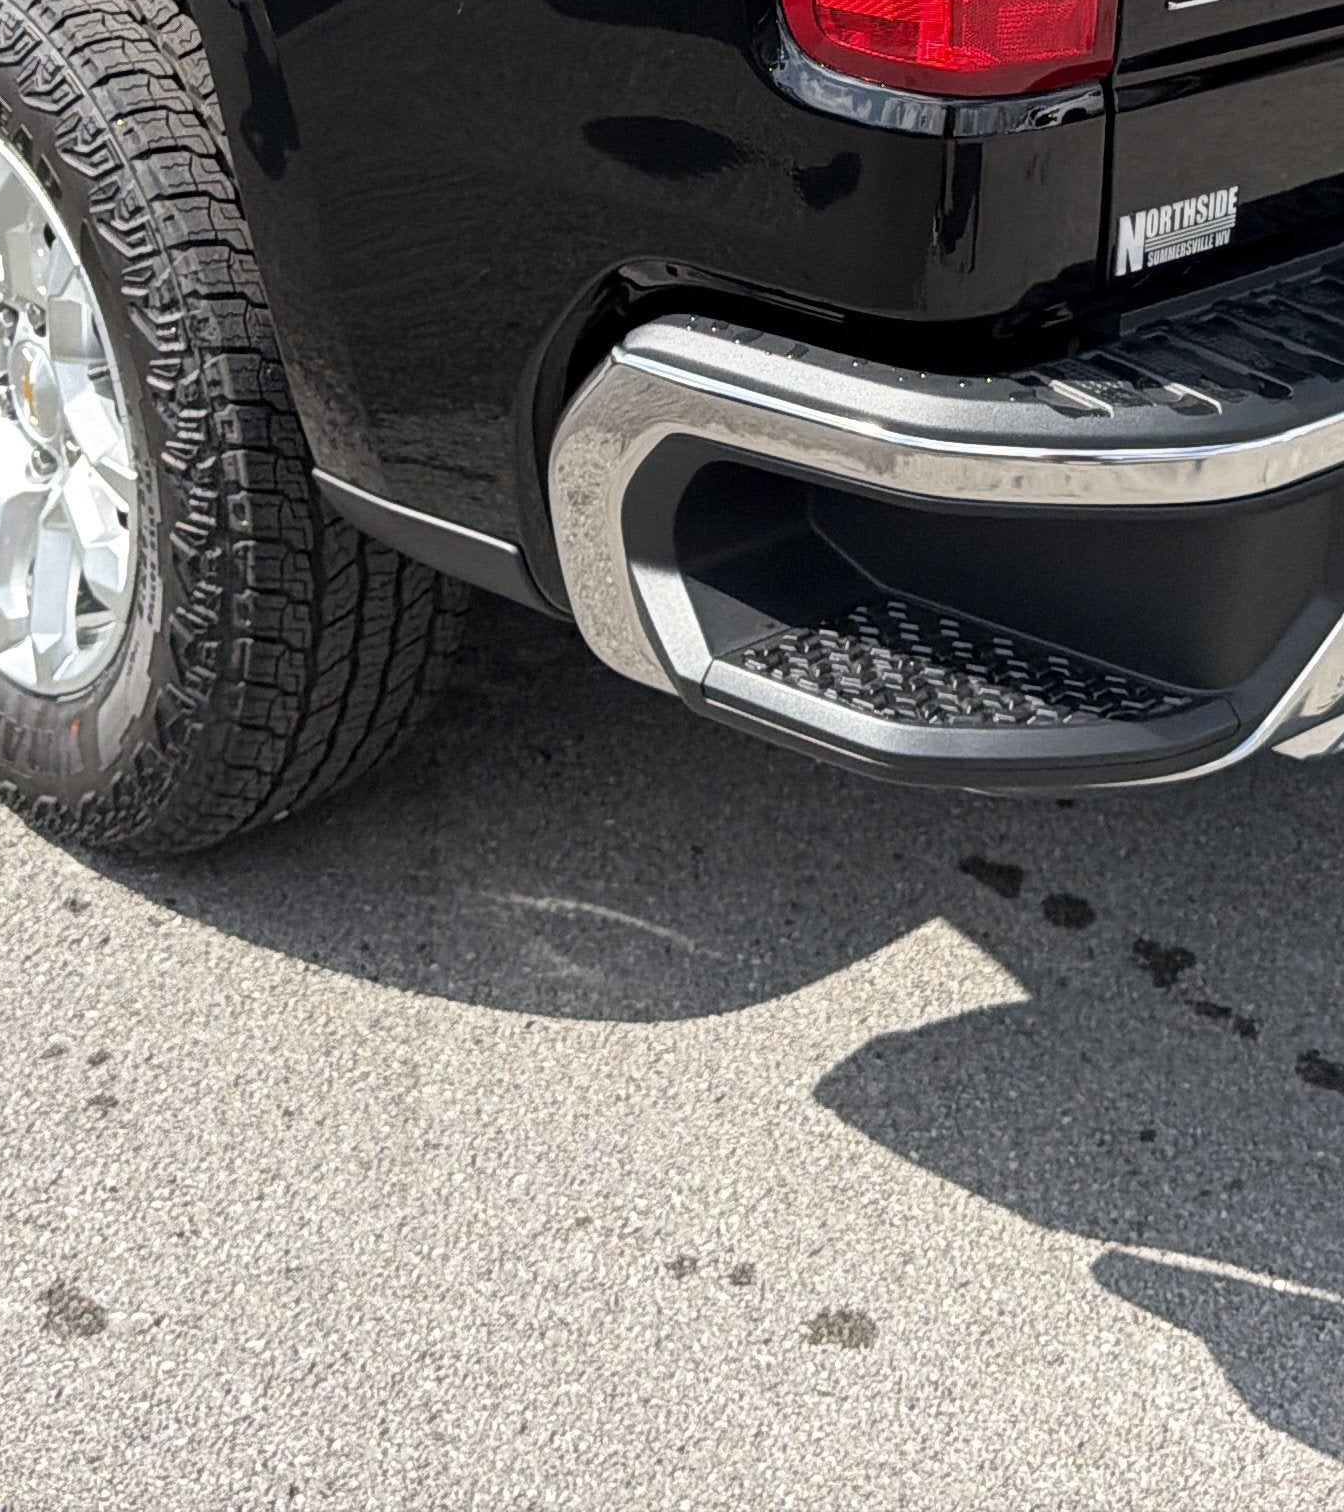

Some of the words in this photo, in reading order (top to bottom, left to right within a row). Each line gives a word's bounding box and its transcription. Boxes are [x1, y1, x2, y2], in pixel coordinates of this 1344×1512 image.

[1115, 185, 1238, 276] NORTHSIDE
[1147, 233, 1214, 267] SUMMERSVILLE
[1215, 228, 1231, 248] WV
